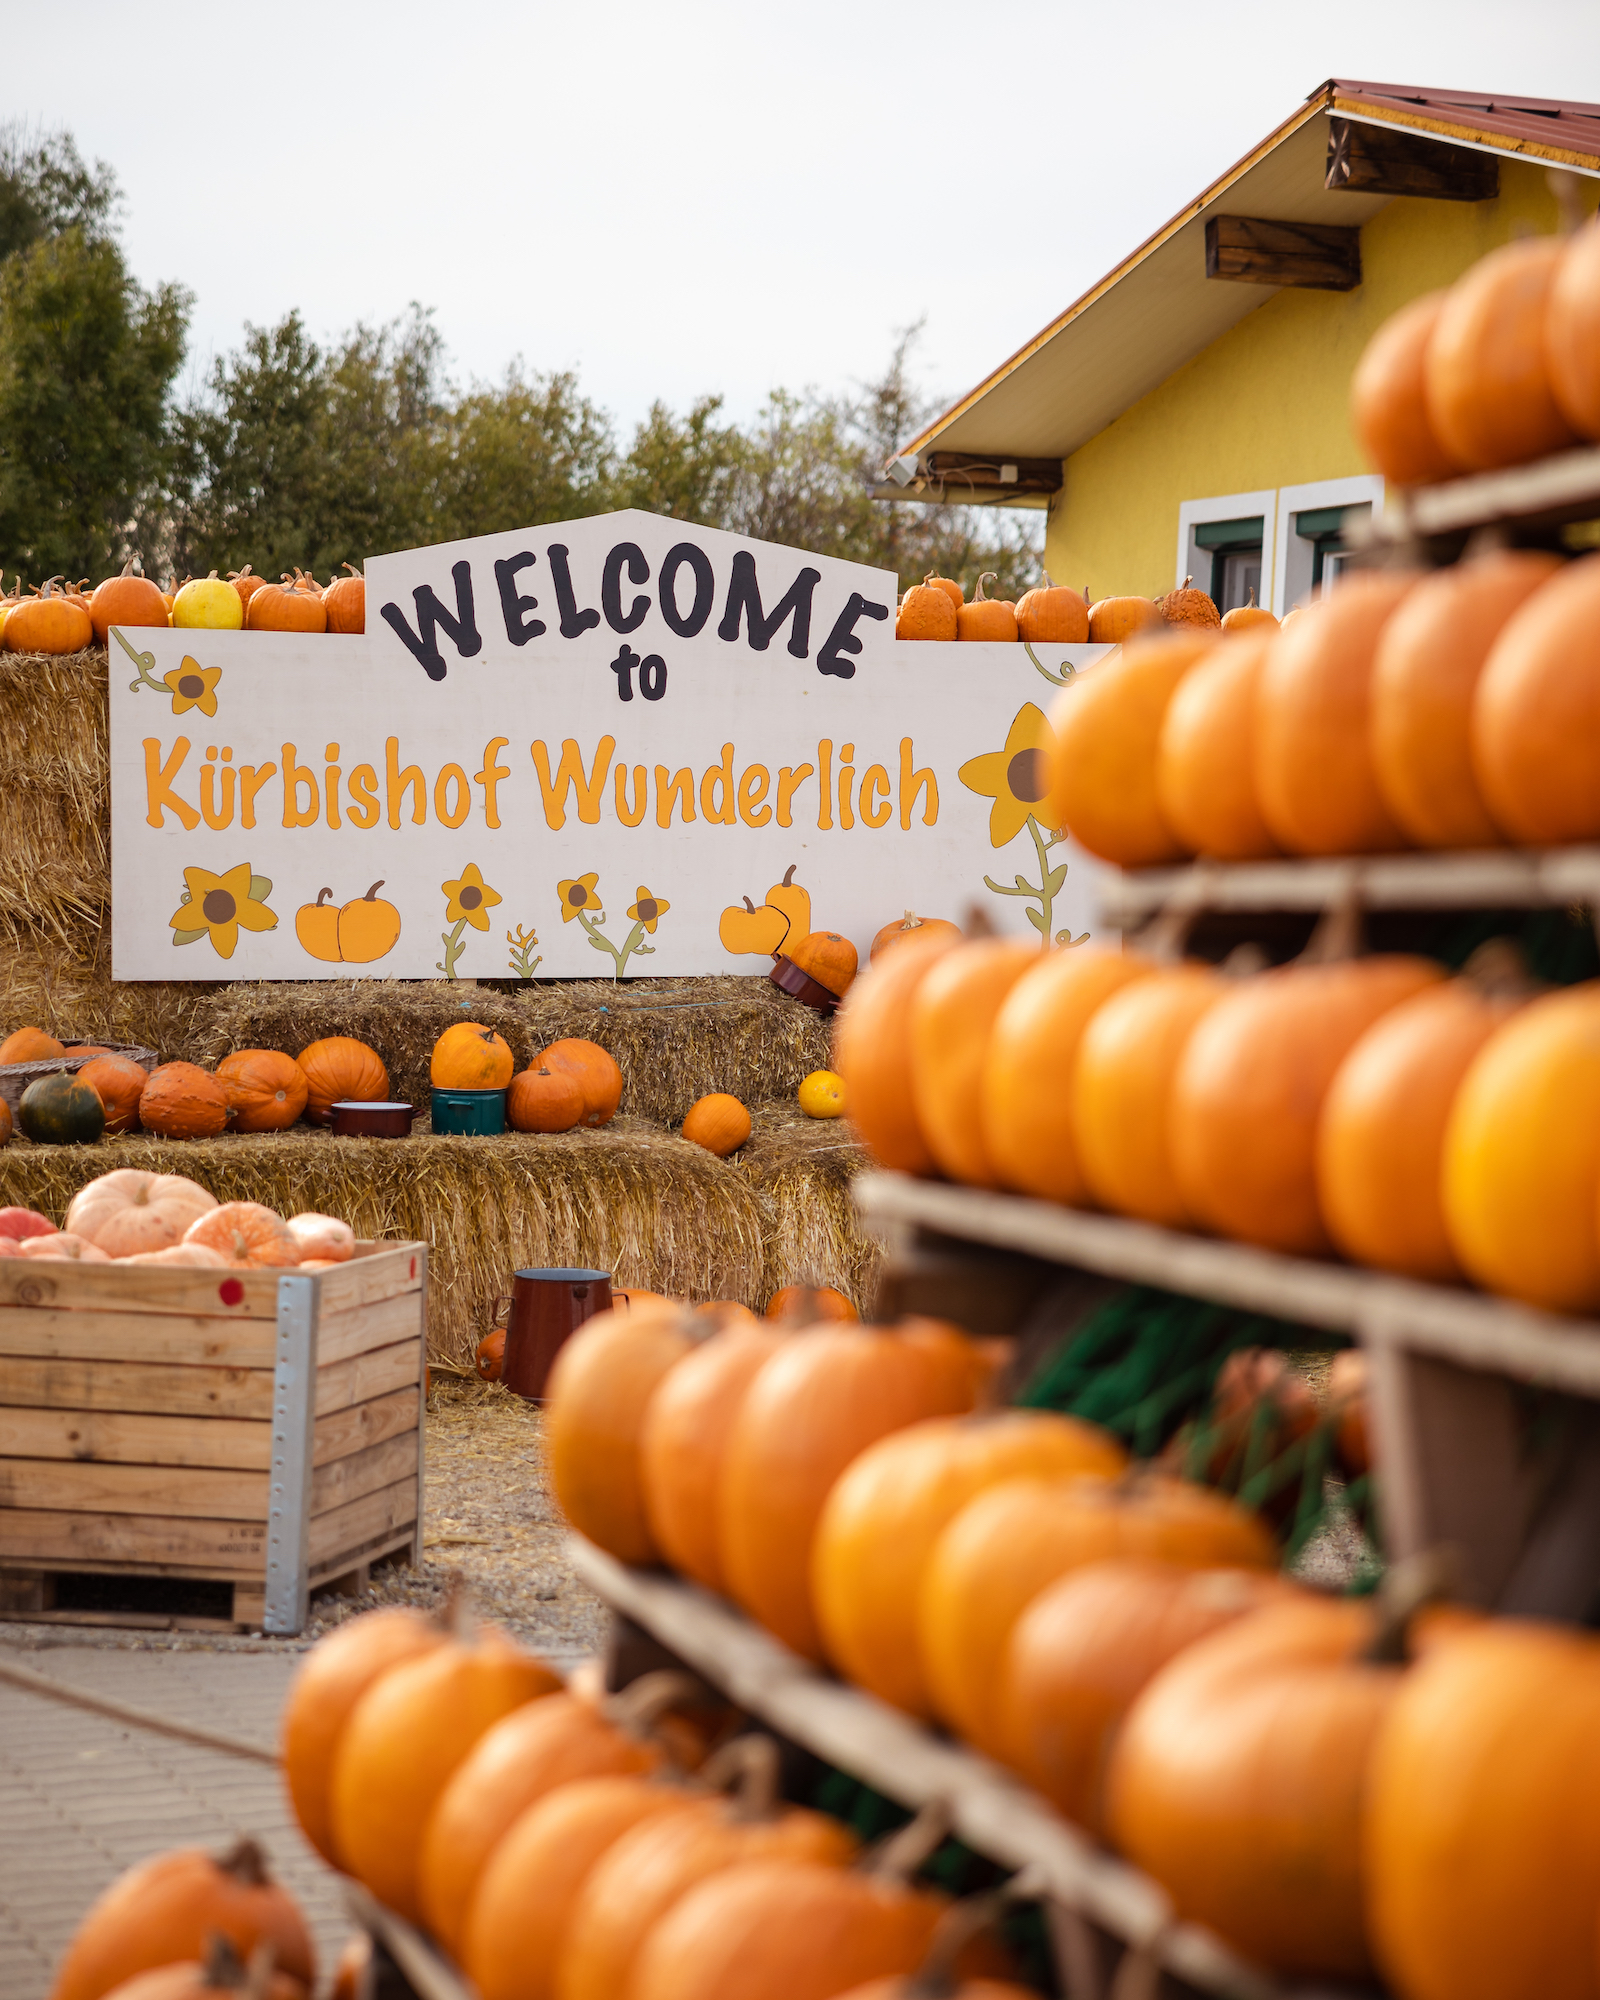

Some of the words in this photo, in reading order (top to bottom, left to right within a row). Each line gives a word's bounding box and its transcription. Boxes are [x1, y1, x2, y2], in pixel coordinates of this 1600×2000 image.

[381, 542, 889, 682] WELCOME
[609, 644, 668, 702] to
[142, 736, 510, 831] Kürbishof
[531, 735, 940, 831] Wunderlich
